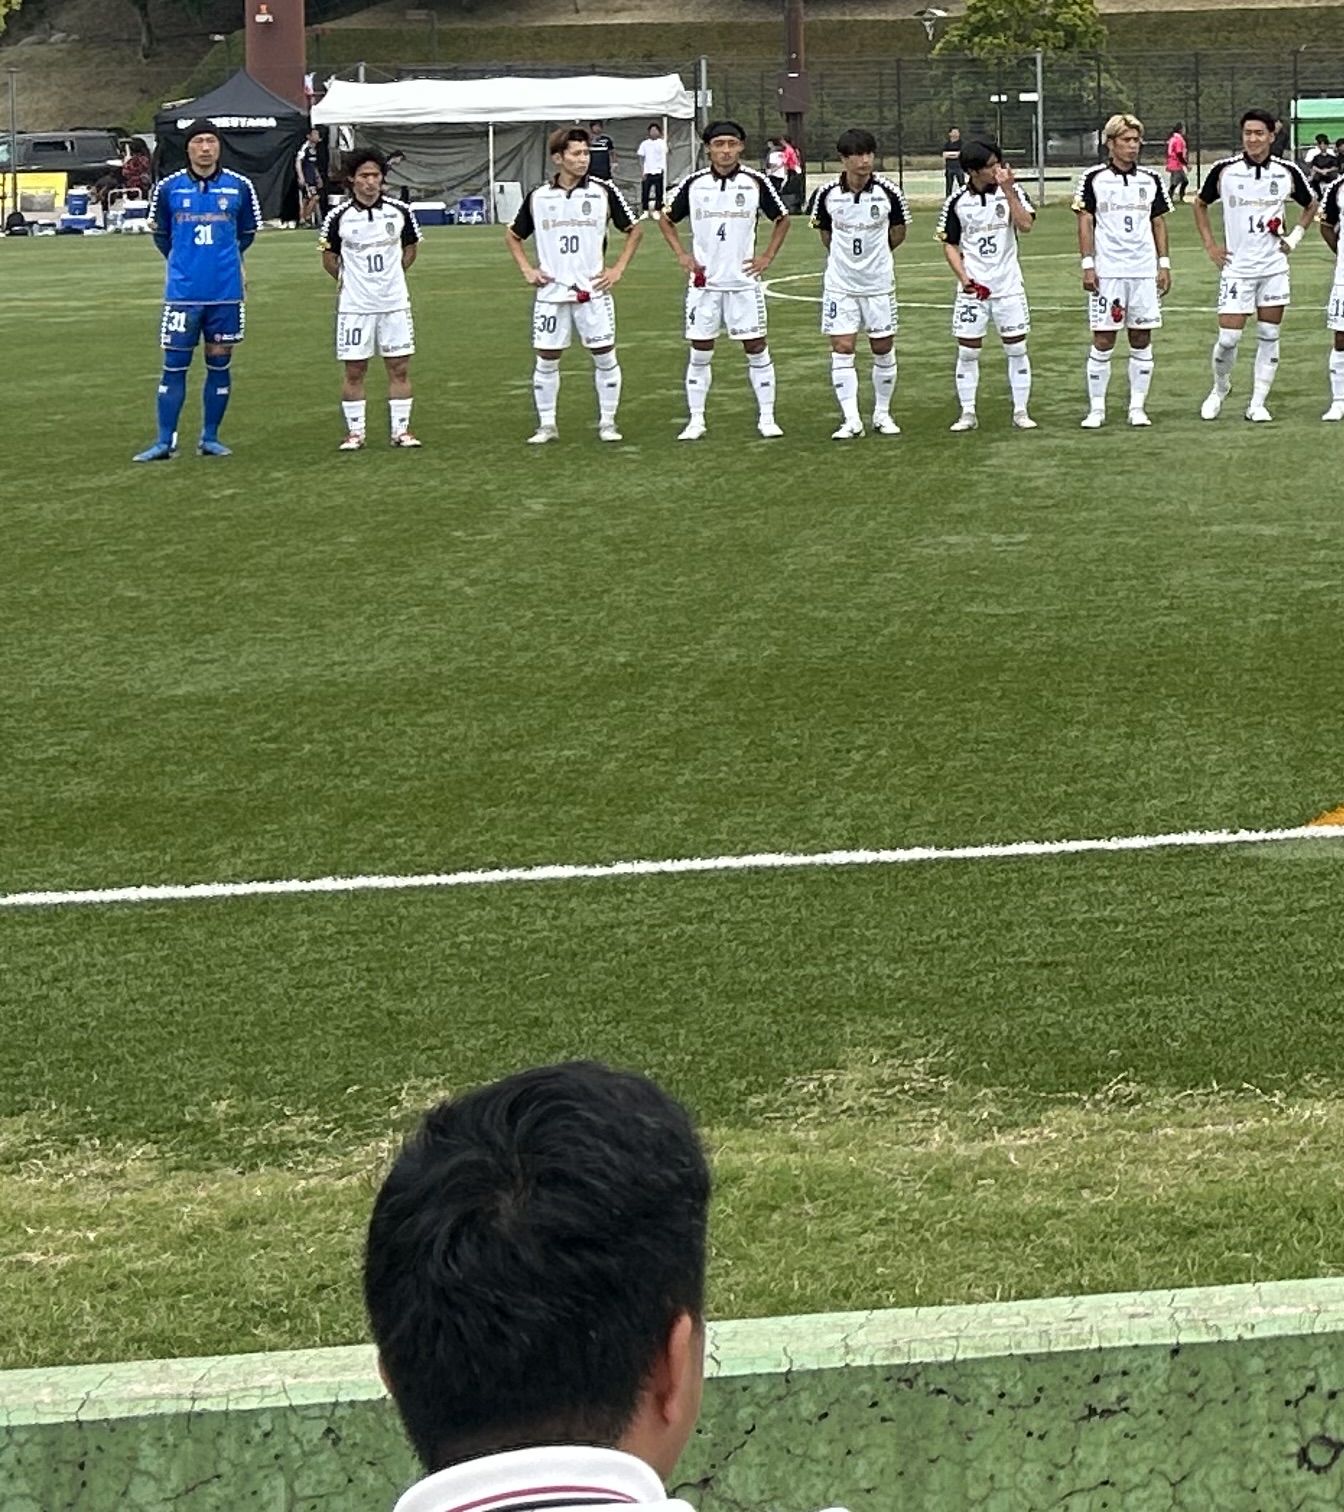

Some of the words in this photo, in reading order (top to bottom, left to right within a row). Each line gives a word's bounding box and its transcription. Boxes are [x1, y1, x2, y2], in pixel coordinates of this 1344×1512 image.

[716, 222, 726, 241] 4
[1124, 215, 1133, 233] 9
[1248, 215, 1265, 233] 14
[194, 223, 214, 245] 31
[559, 235, 579, 254] 30
[852, 238, 862, 256] 8
[977, 236, 997, 256] 25
[366, 253, 384, 273] 10
[960, 304, 978, 323] 25
[1098, 296, 1108, 314] 9
[168, 311, 186, 333] 31
[538, 315, 557, 333] 30
[688, 306, 697, 325] 4
[344, 328, 362, 346] 10
